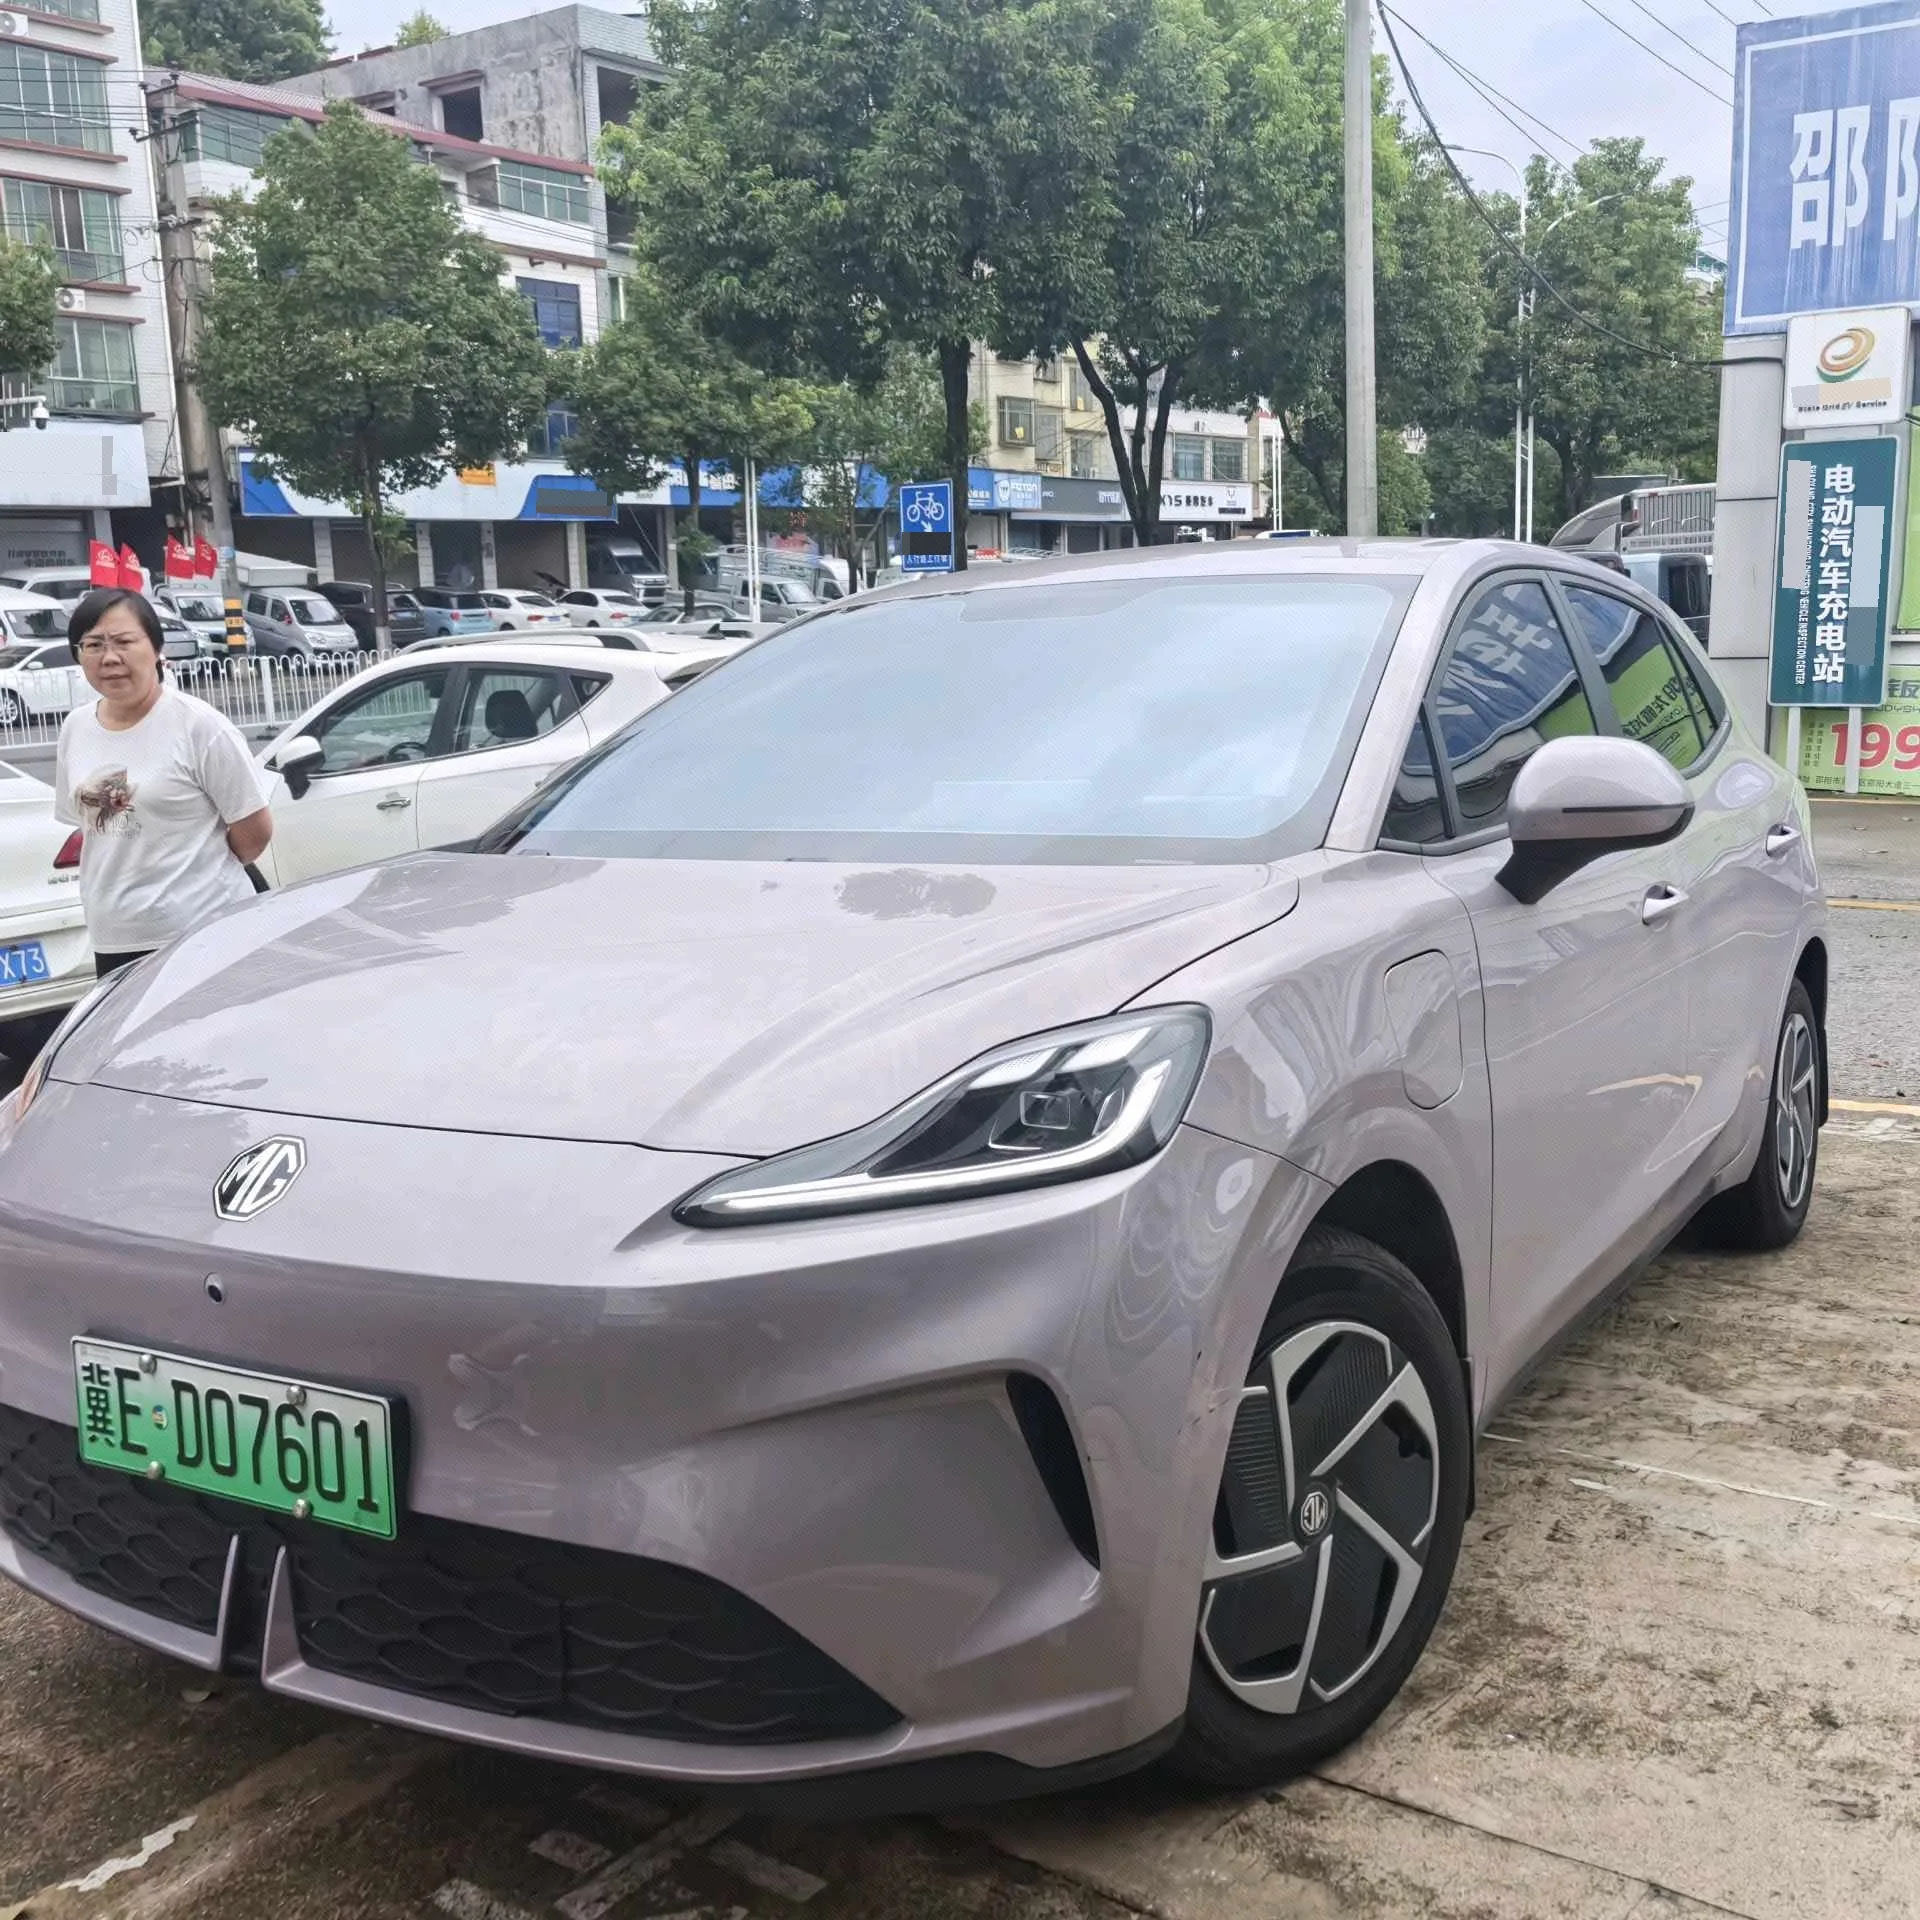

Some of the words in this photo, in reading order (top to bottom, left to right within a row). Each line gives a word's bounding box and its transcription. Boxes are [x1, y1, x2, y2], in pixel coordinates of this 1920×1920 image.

[1798, 405, 1820, 413] State
[1822, 403, 1840, 411] Grid
[1856, 399, 1887, 408] Service
[1812, 463, 1856, 683] 电动汽车充电站
[1798, 597, 1809, 622] VEHICLE
[1796, 622, 1808, 660] INSPECTION
[1795, 660, 1806, 685] CENTER
[0, 947, 45, 980] X73
[218, 1140, 301, 1217] MG
[1303, 1495, 1327, 1531] MG
